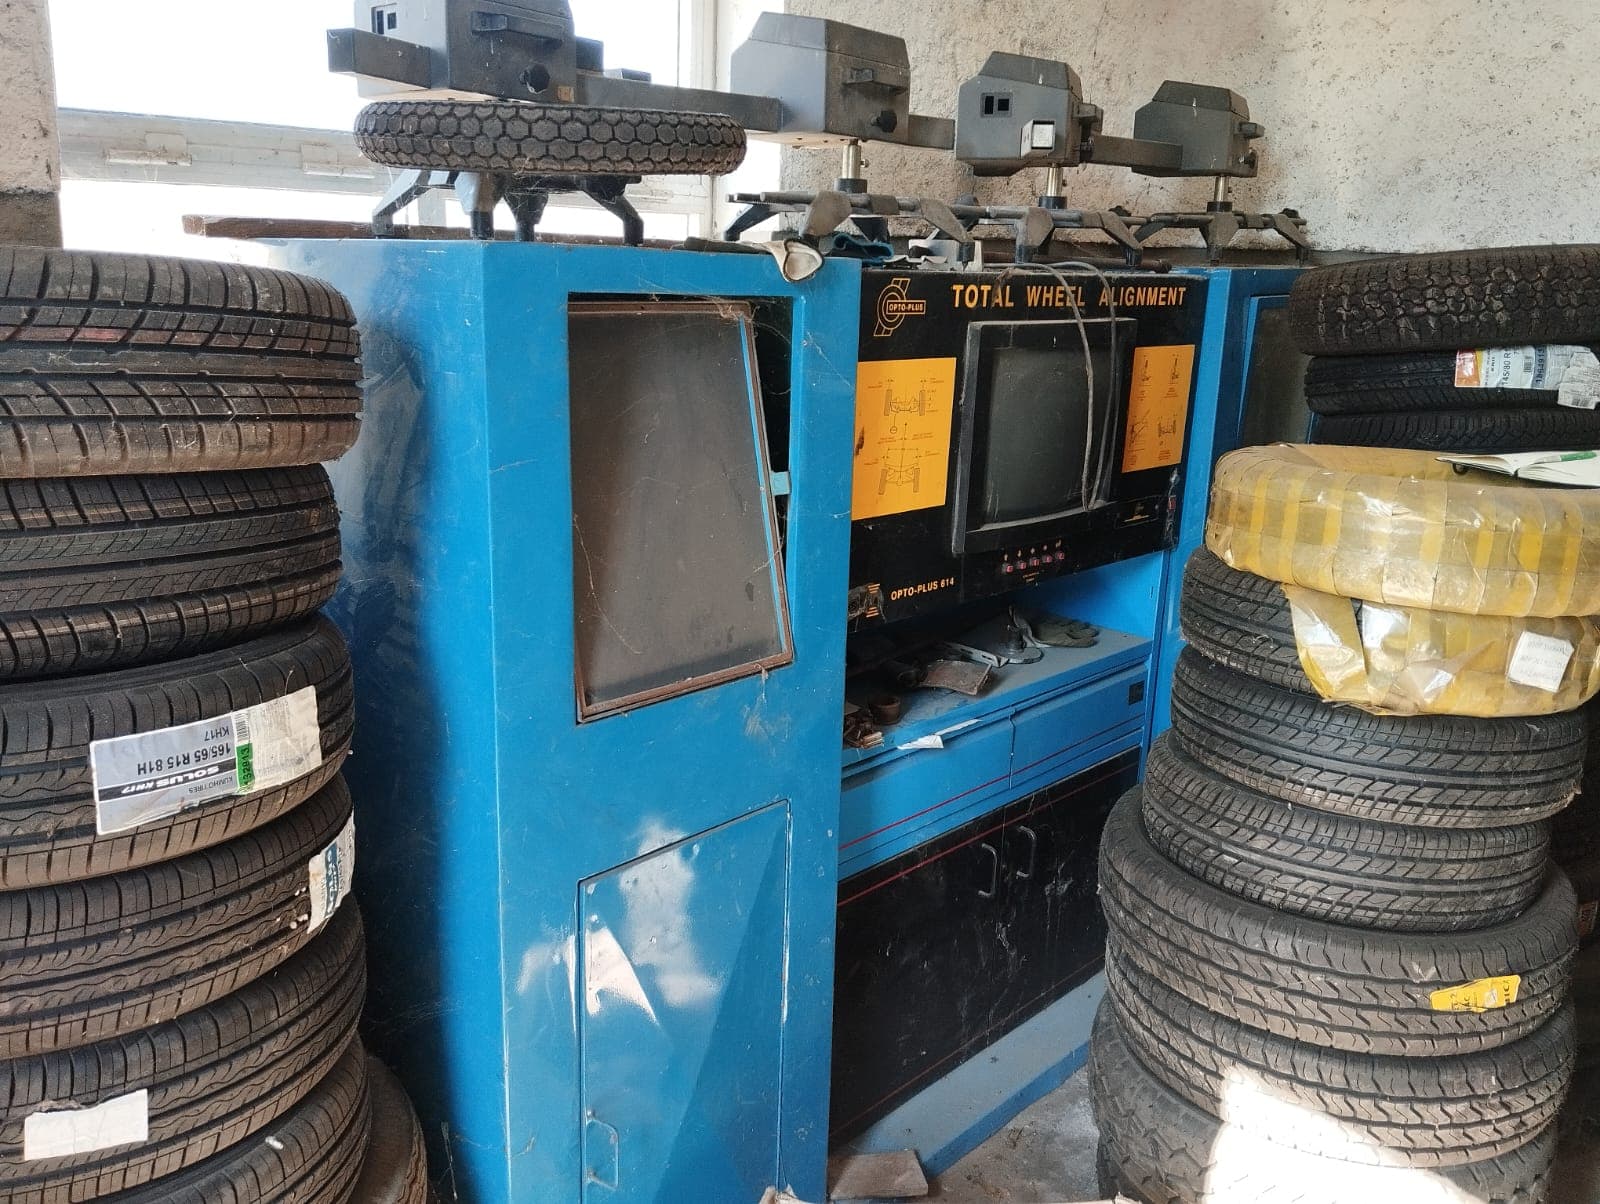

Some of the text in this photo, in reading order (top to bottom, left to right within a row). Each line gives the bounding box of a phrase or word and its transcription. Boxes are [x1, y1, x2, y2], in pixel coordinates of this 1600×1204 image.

[952, 284, 1187, 308] TOTAL WHEEL ALIGNMENT
[888, 303, 924, 312] OPTO-PLUS
[890, 580, 938, 600] OPTO-PLUS
[204, 726, 230, 741] KH17
[137, 743, 231, 776] 165/65 R15 81H
[156, 765, 220, 788] SOLUS
[208, 775, 233, 789] KUMHO
